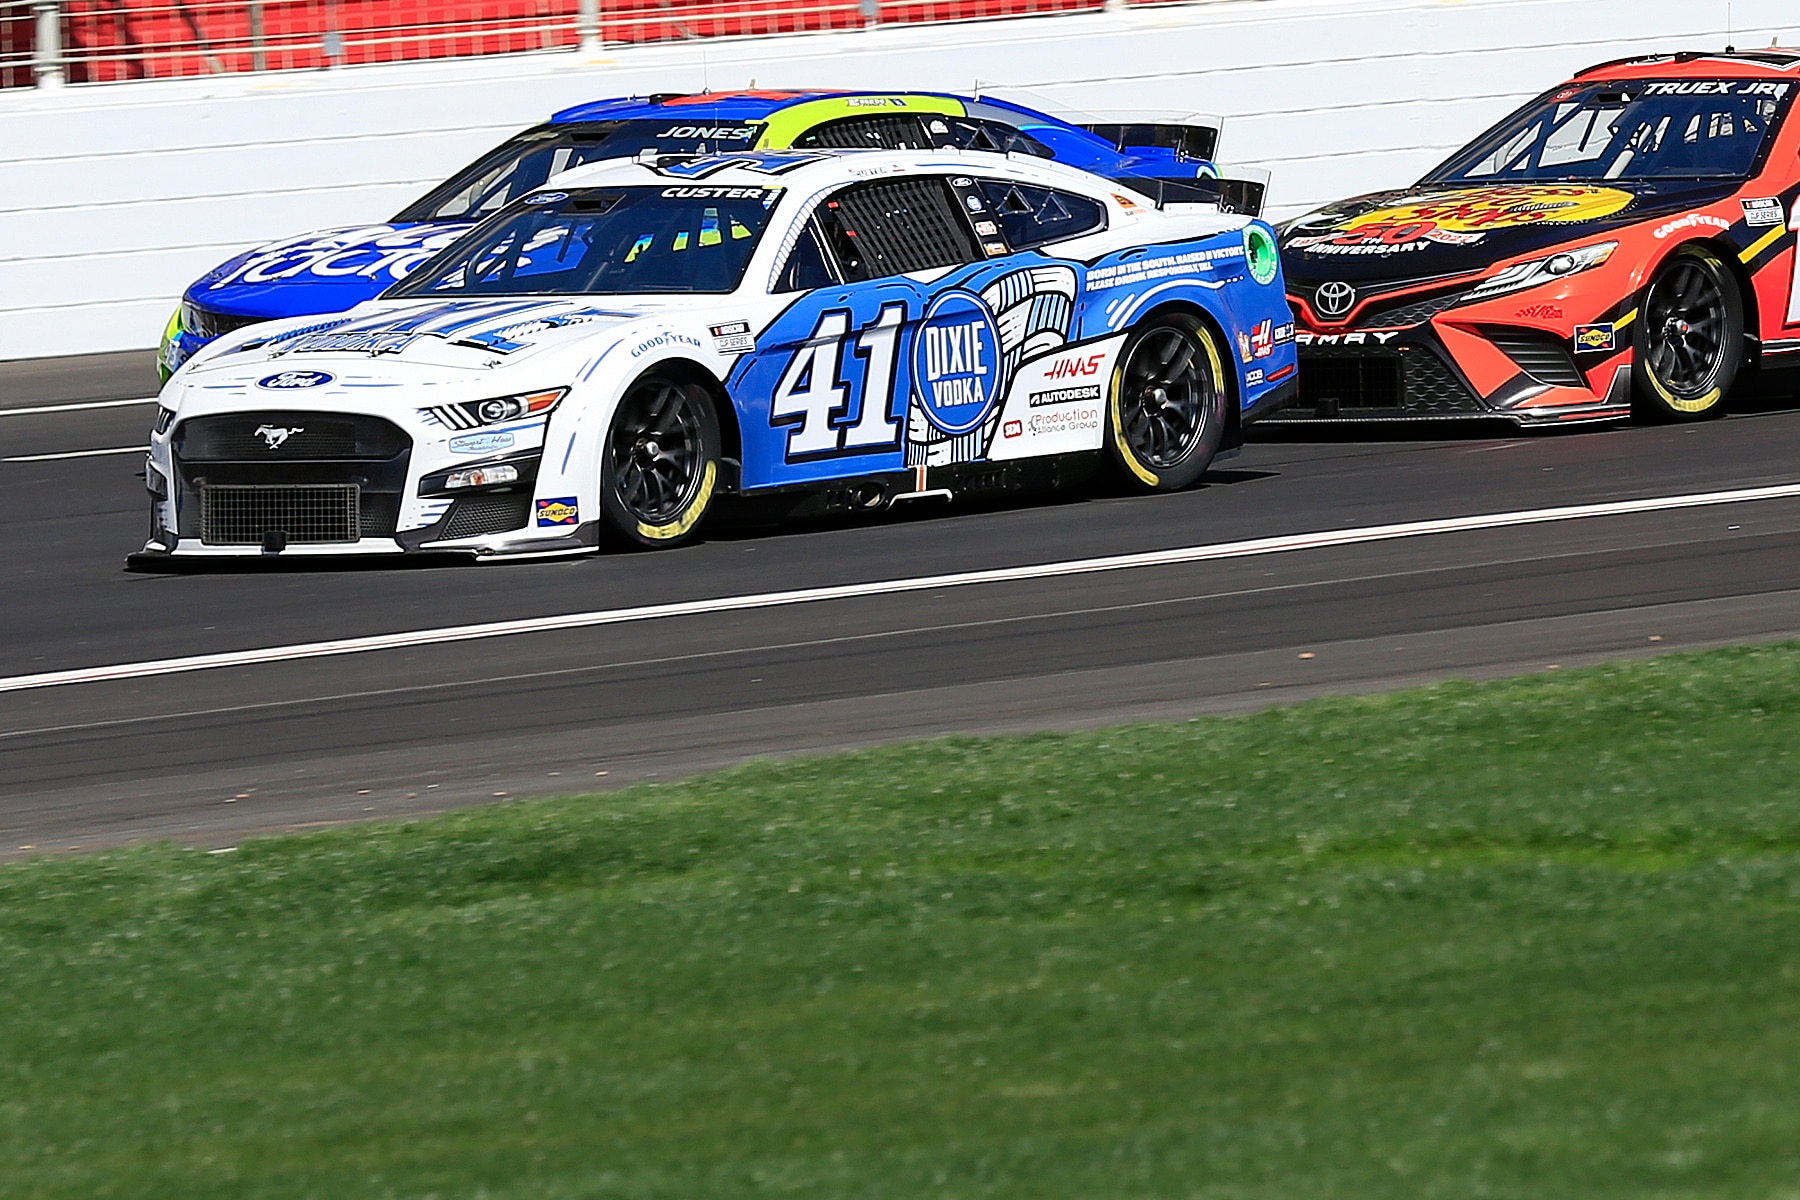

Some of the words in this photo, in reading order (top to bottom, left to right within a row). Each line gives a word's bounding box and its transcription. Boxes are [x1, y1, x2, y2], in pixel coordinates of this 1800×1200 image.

[1644, 81, 1732, 96] TRUEX
[1736, 81, 1778, 96] JR
[656, 126, 748, 139] JONES
[661, 187, 764, 199] CUSTER
[1304, 240, 1432, 256] ANNIVERSARY
[1294, 331, 1399, 346] AMRY
[1578, 333, 1611, 343] SUNOCO
[925, 320, 988, 382] DIXIE
[1043, 353, 1106, 380] HAAS
[267, 371, 323, 388] Ford
[771, 303, 905, 460] 41
[932, 375, 985, 409] VODKA
[1041, 386, 1099, 404] AUTODESK
[1035, 408, 1098, 427] Production
[1068, 420, 1098, 430] Group
[538, 506, 576, 518] SUNOCO
